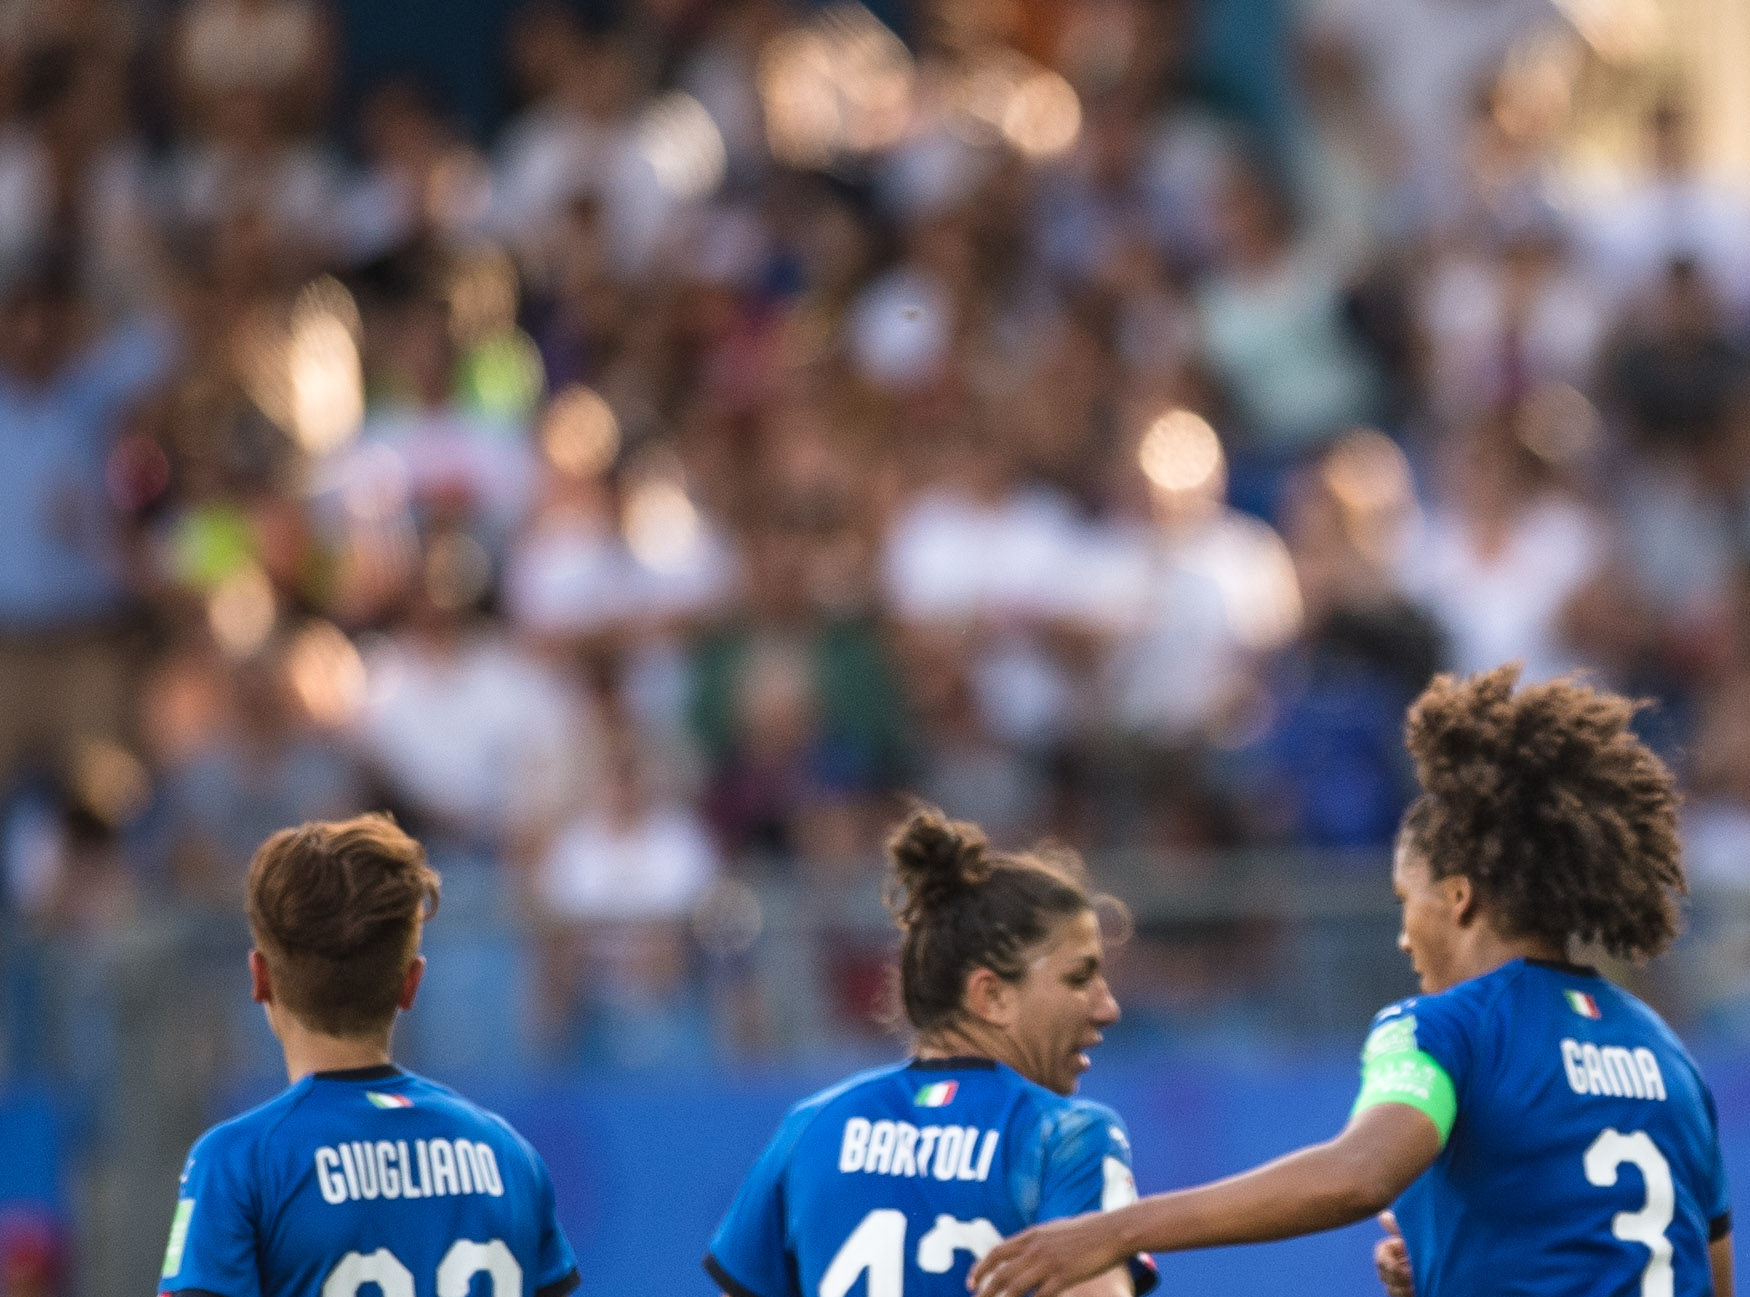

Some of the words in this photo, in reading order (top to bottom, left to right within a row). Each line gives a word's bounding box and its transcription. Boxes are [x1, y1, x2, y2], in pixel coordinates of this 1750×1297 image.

[1560, 1038, 1666, 1101] GAMA
[314, 1137, 504, 1205] GIUGLIANO
[838, 1117, 1000, 1182] BARTOLI
